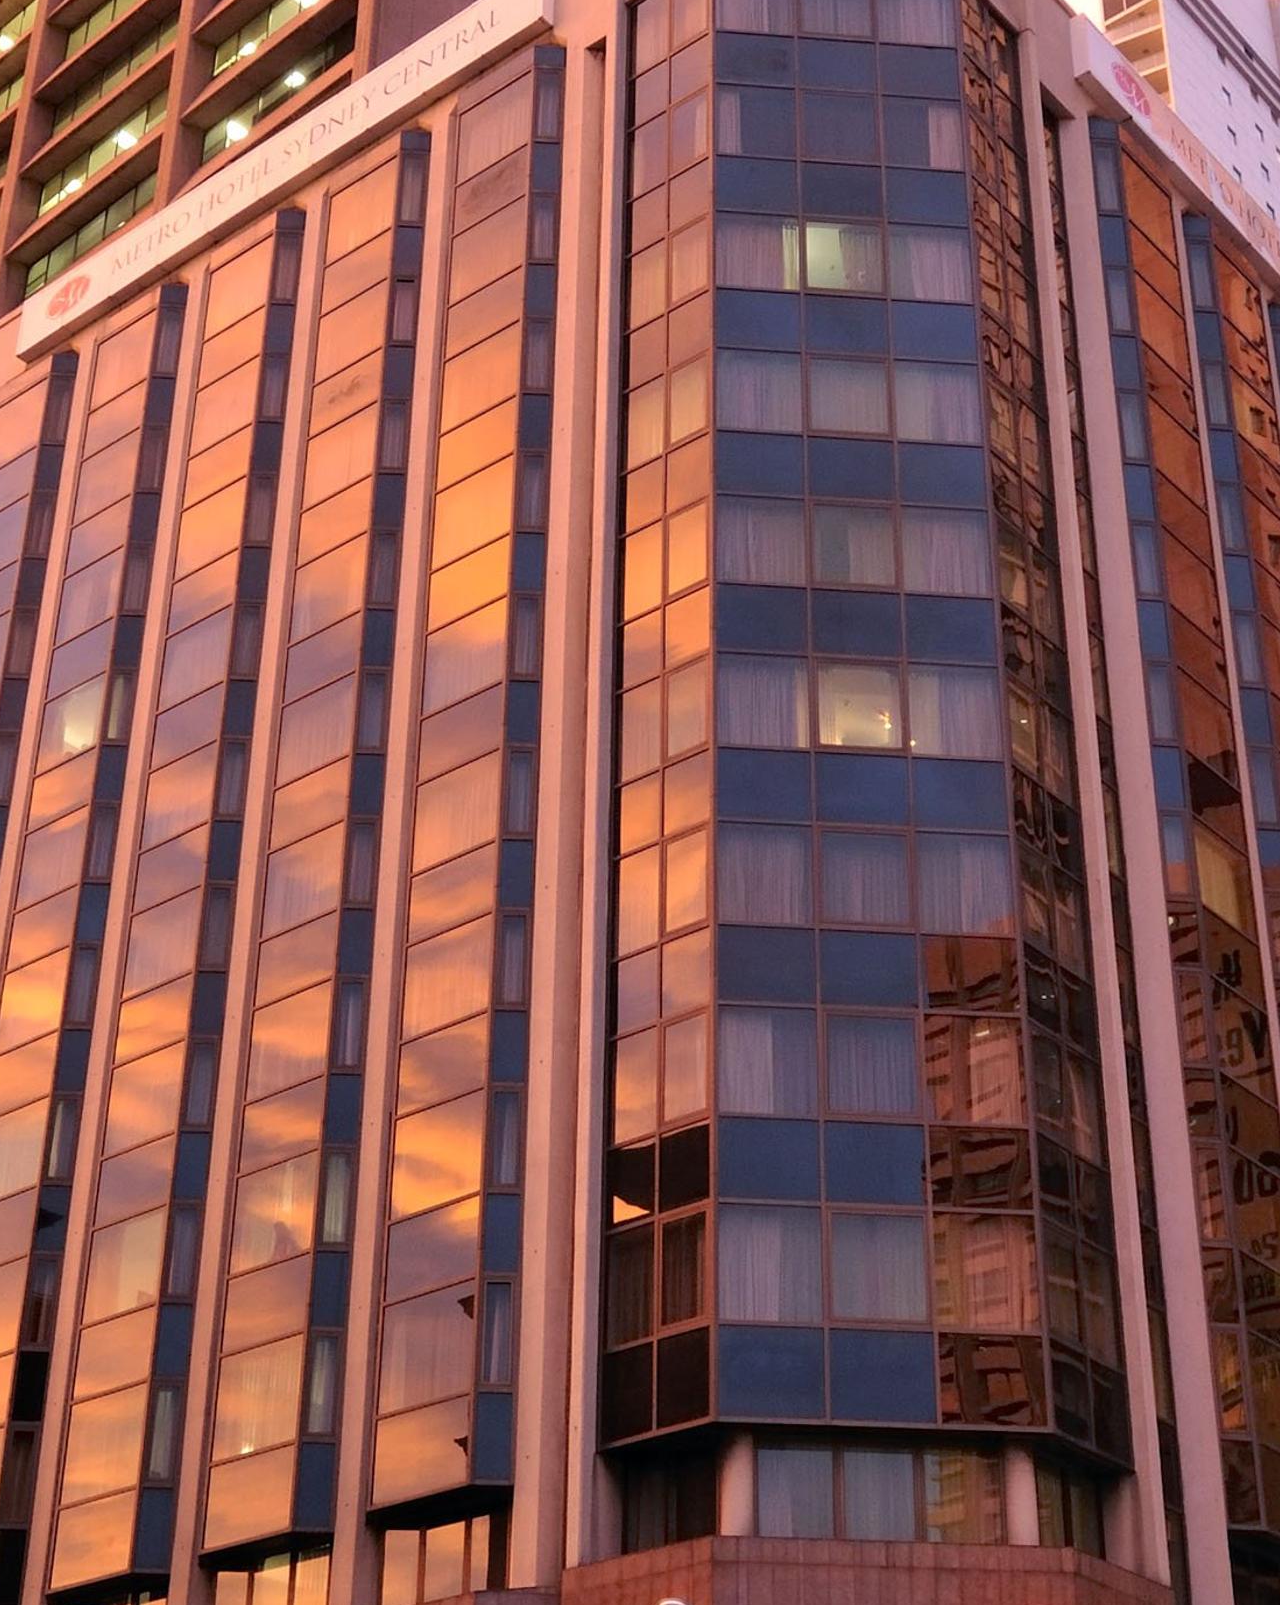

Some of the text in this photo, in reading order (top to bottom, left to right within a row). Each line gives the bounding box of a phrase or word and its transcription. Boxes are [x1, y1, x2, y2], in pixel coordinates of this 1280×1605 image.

[111, 10, 501, 274] METRO HOTEL SYDNEY CENTRAL
